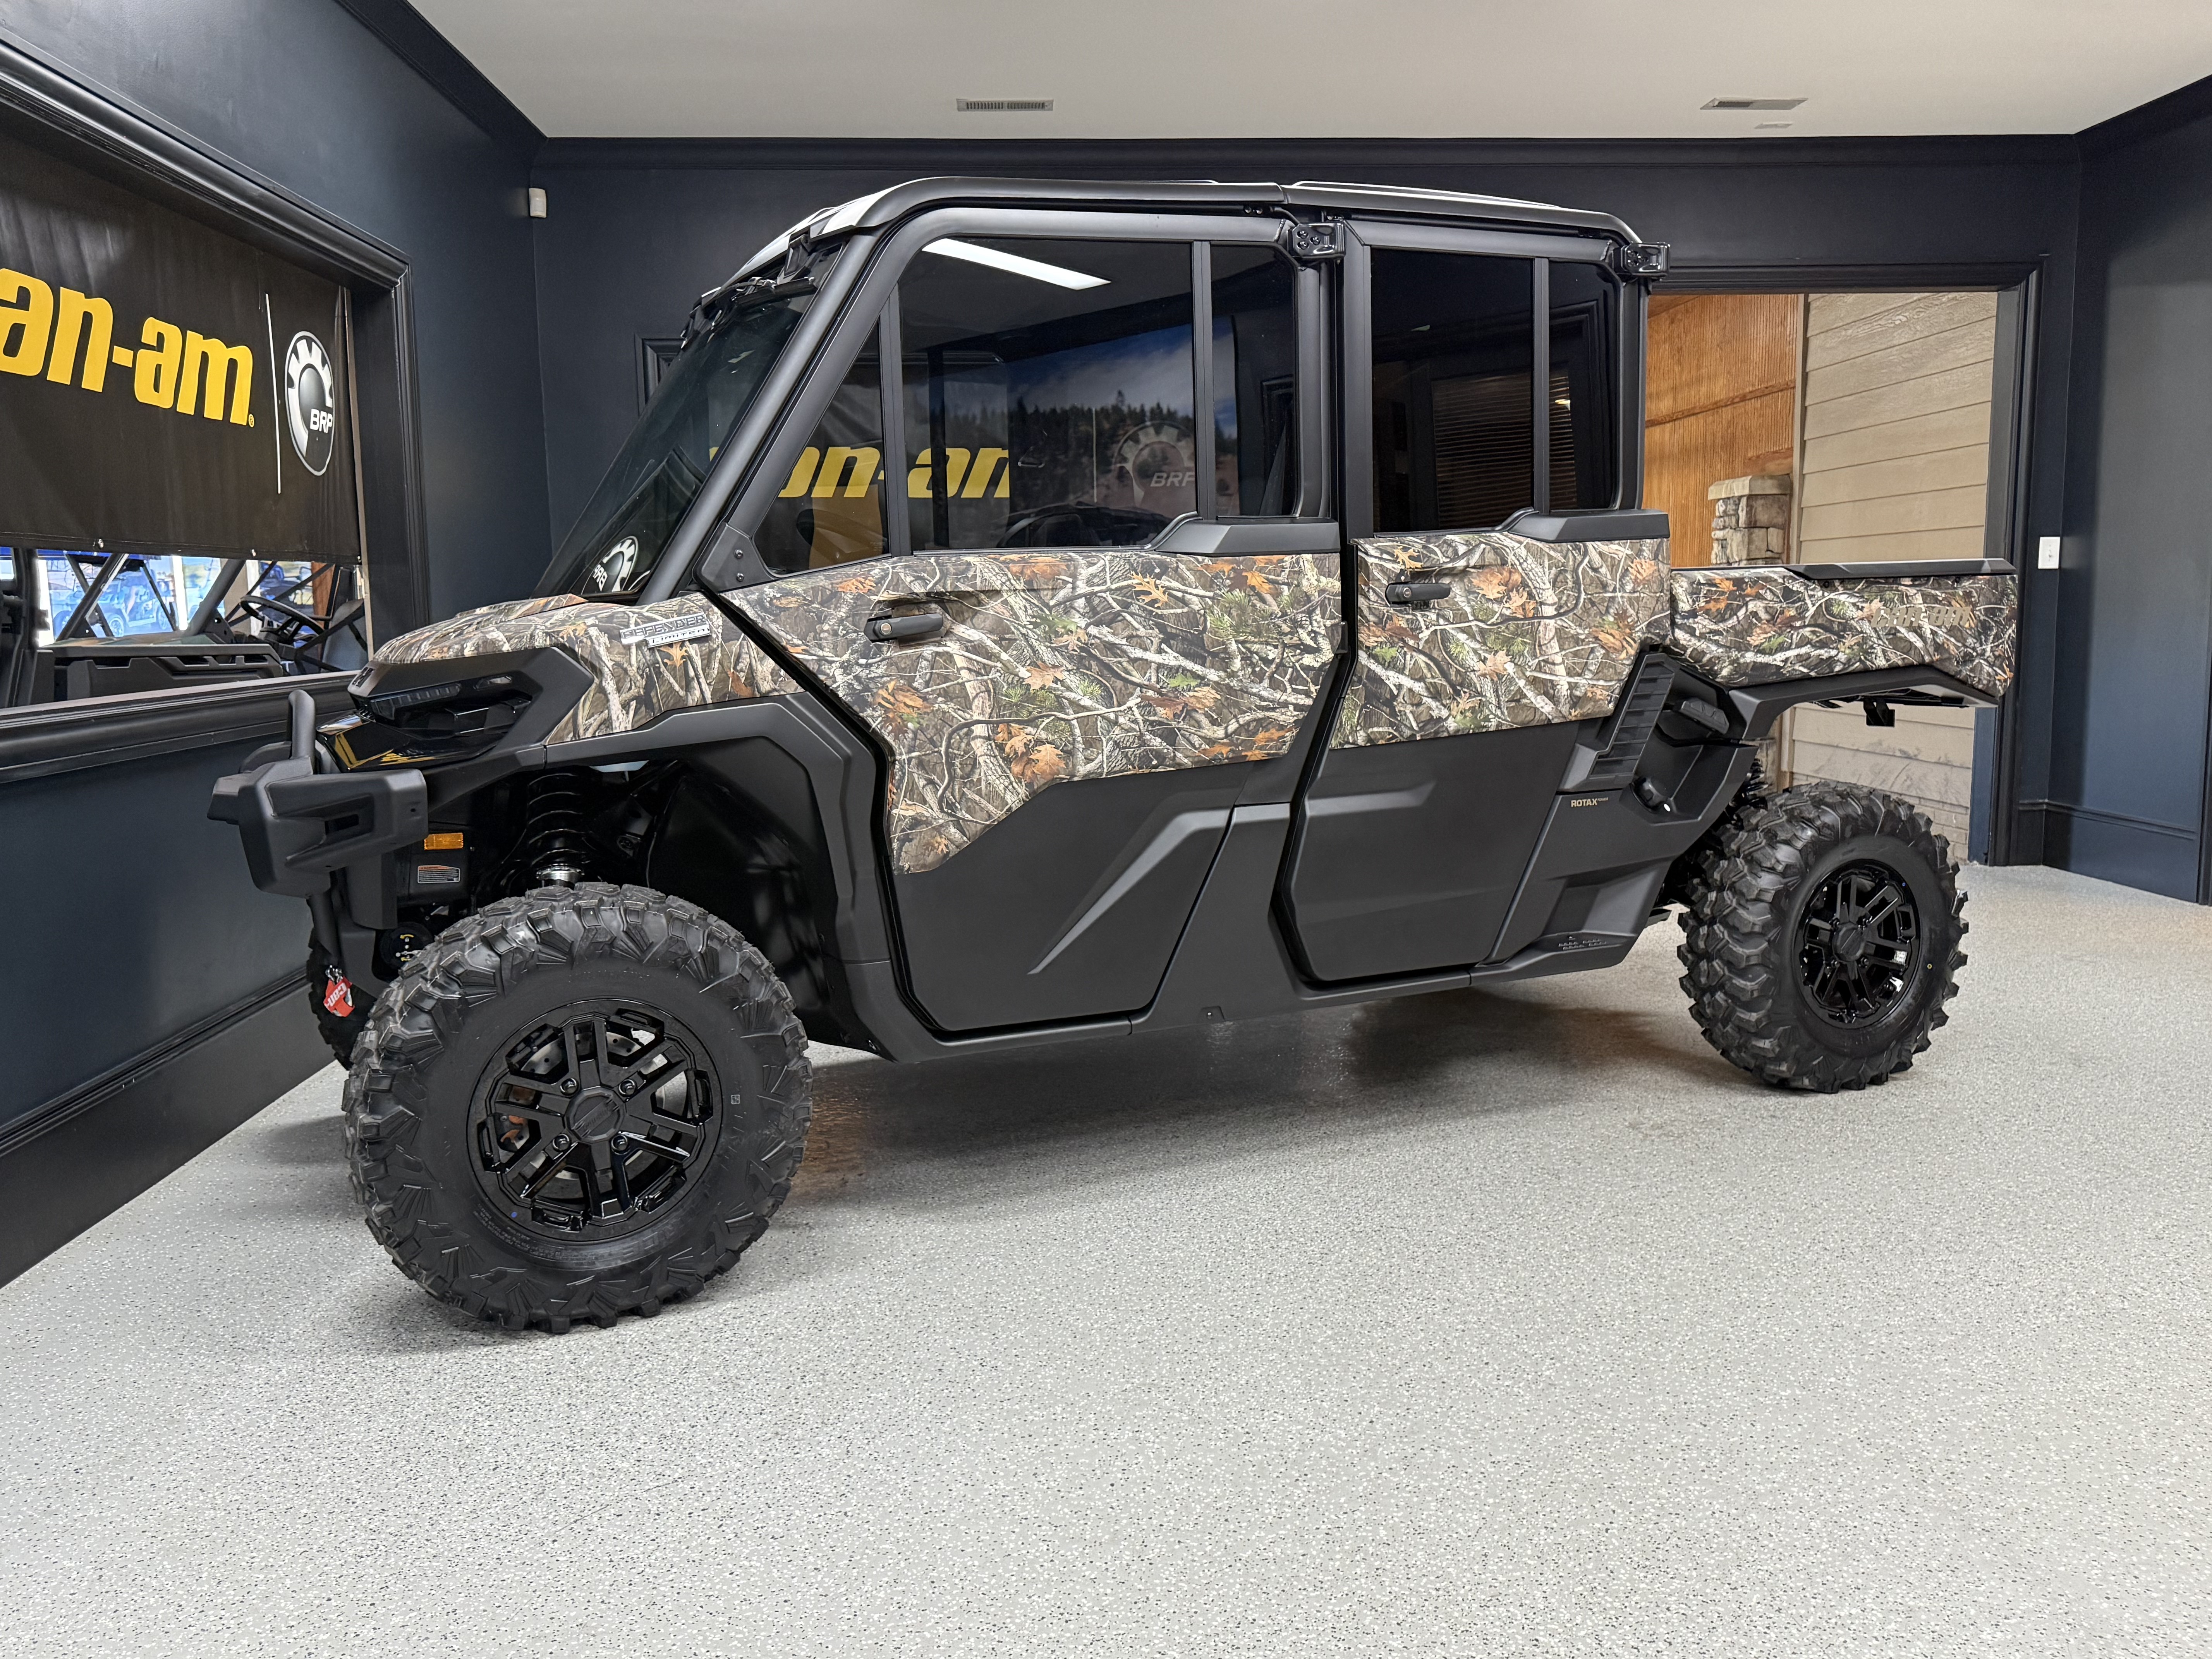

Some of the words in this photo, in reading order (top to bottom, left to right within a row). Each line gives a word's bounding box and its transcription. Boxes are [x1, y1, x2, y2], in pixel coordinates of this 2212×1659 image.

[310, 409, 333, 433] BRP
[621, 615, 706, 639] DEFENDER
[1571, 798, 1597, 807] ROTAX
